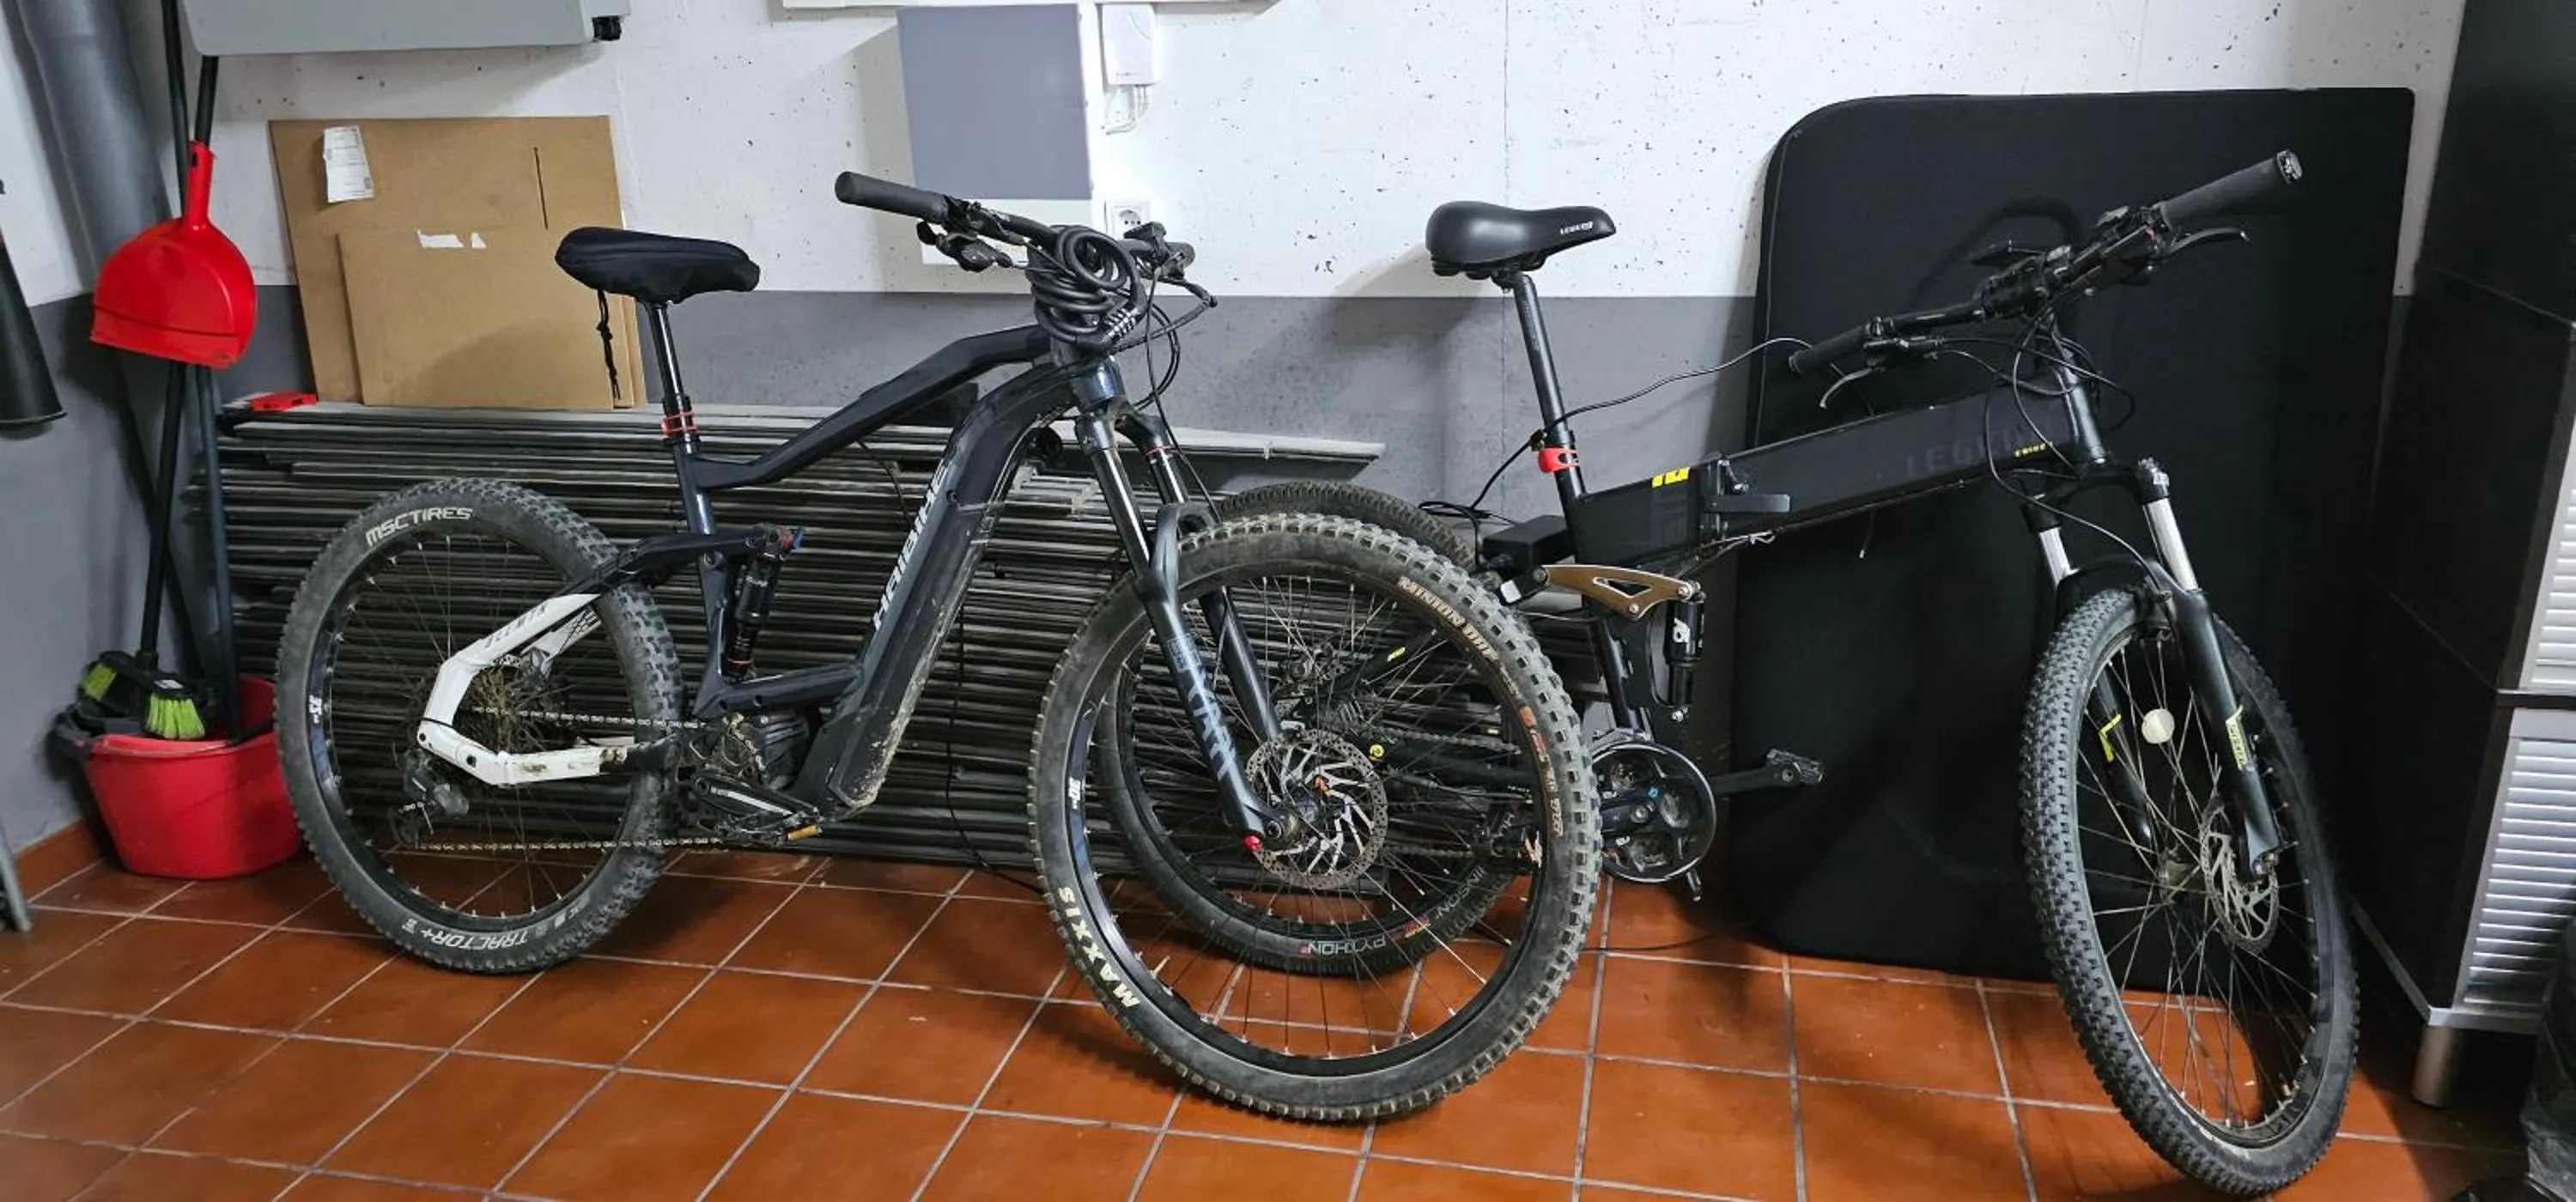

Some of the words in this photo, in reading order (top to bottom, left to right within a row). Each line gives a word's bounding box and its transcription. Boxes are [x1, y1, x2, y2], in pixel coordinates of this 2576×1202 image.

[872, 458, 949, 632] HAIBIKE
[1398, 575, 1466, 628] MINION
[420, 927, 528, 950] TRACTOR+
[1057, 886, 1141, 1008] MAXXIS
[1307, 935, 1387, 956] PYTHON
